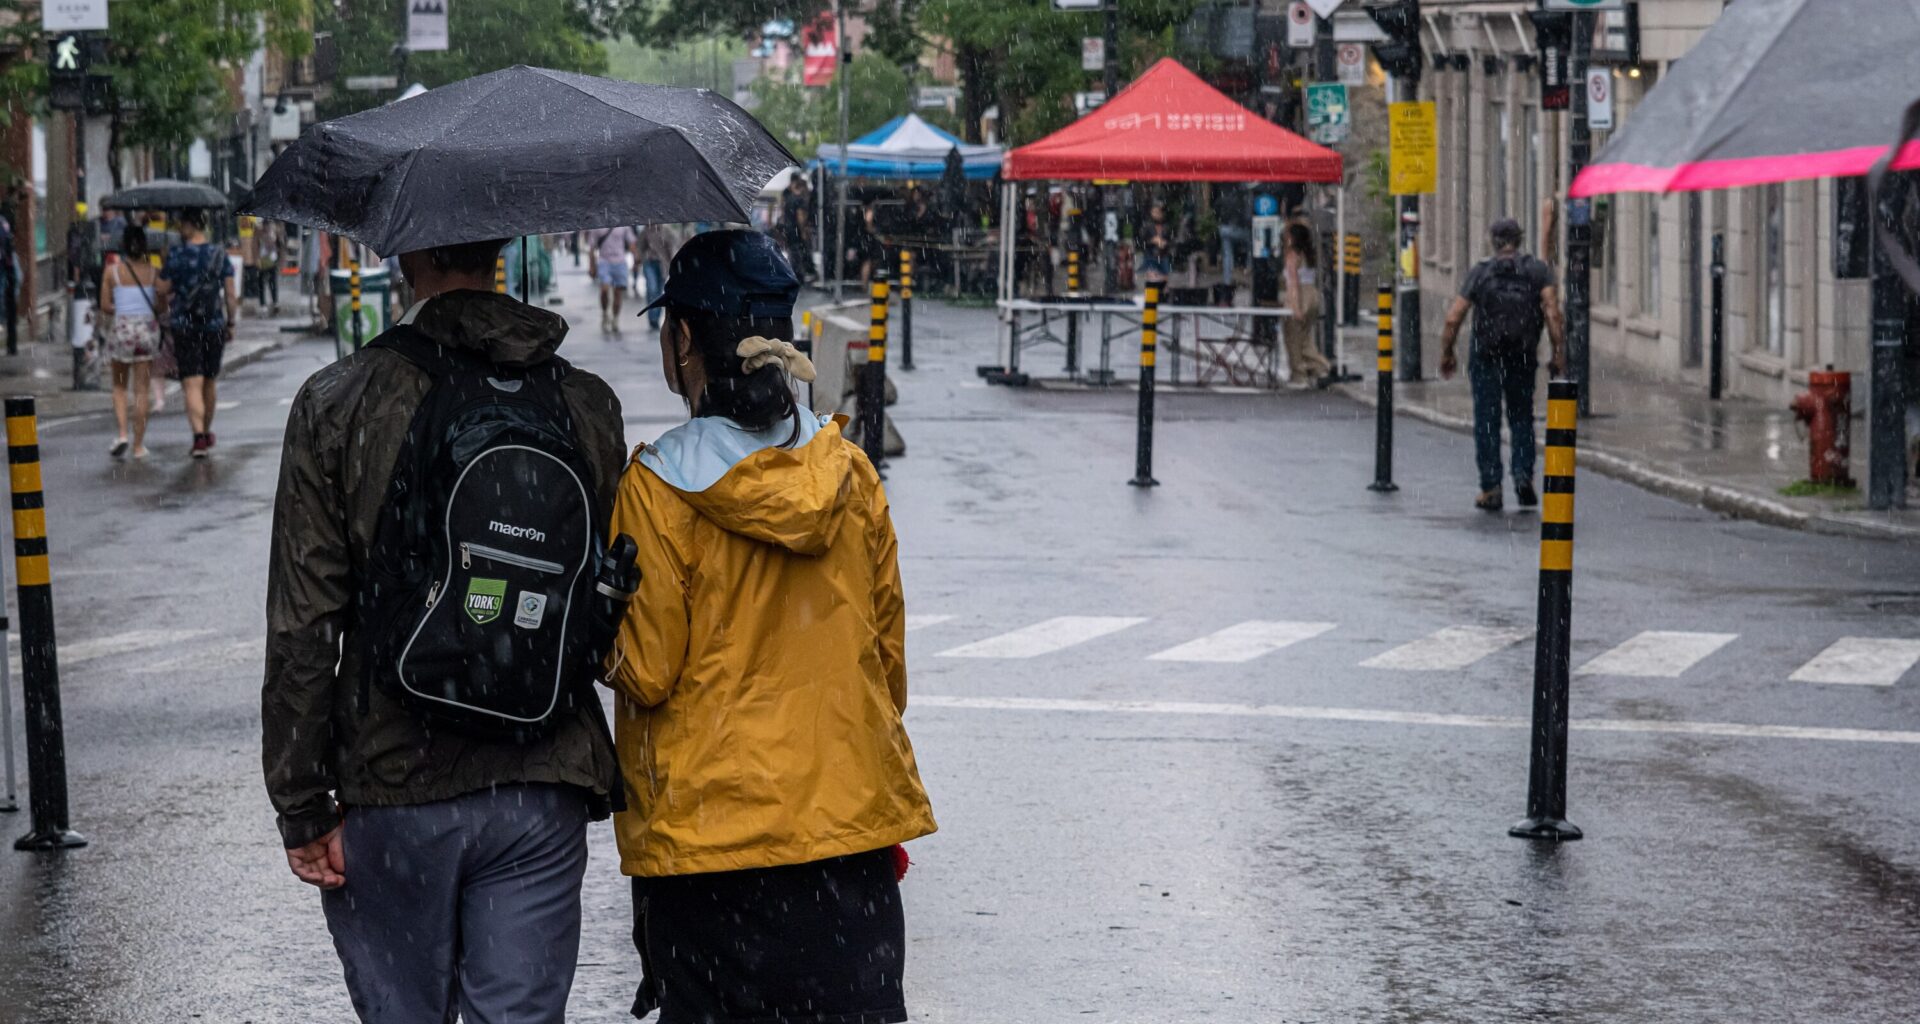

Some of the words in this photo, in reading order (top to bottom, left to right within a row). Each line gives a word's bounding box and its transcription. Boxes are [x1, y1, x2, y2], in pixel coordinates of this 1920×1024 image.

[1167, 122, 1245, 131] OPTIQUE
[489, 520, 546, 543] macron
[469, 594, 500, 610] YORK9
